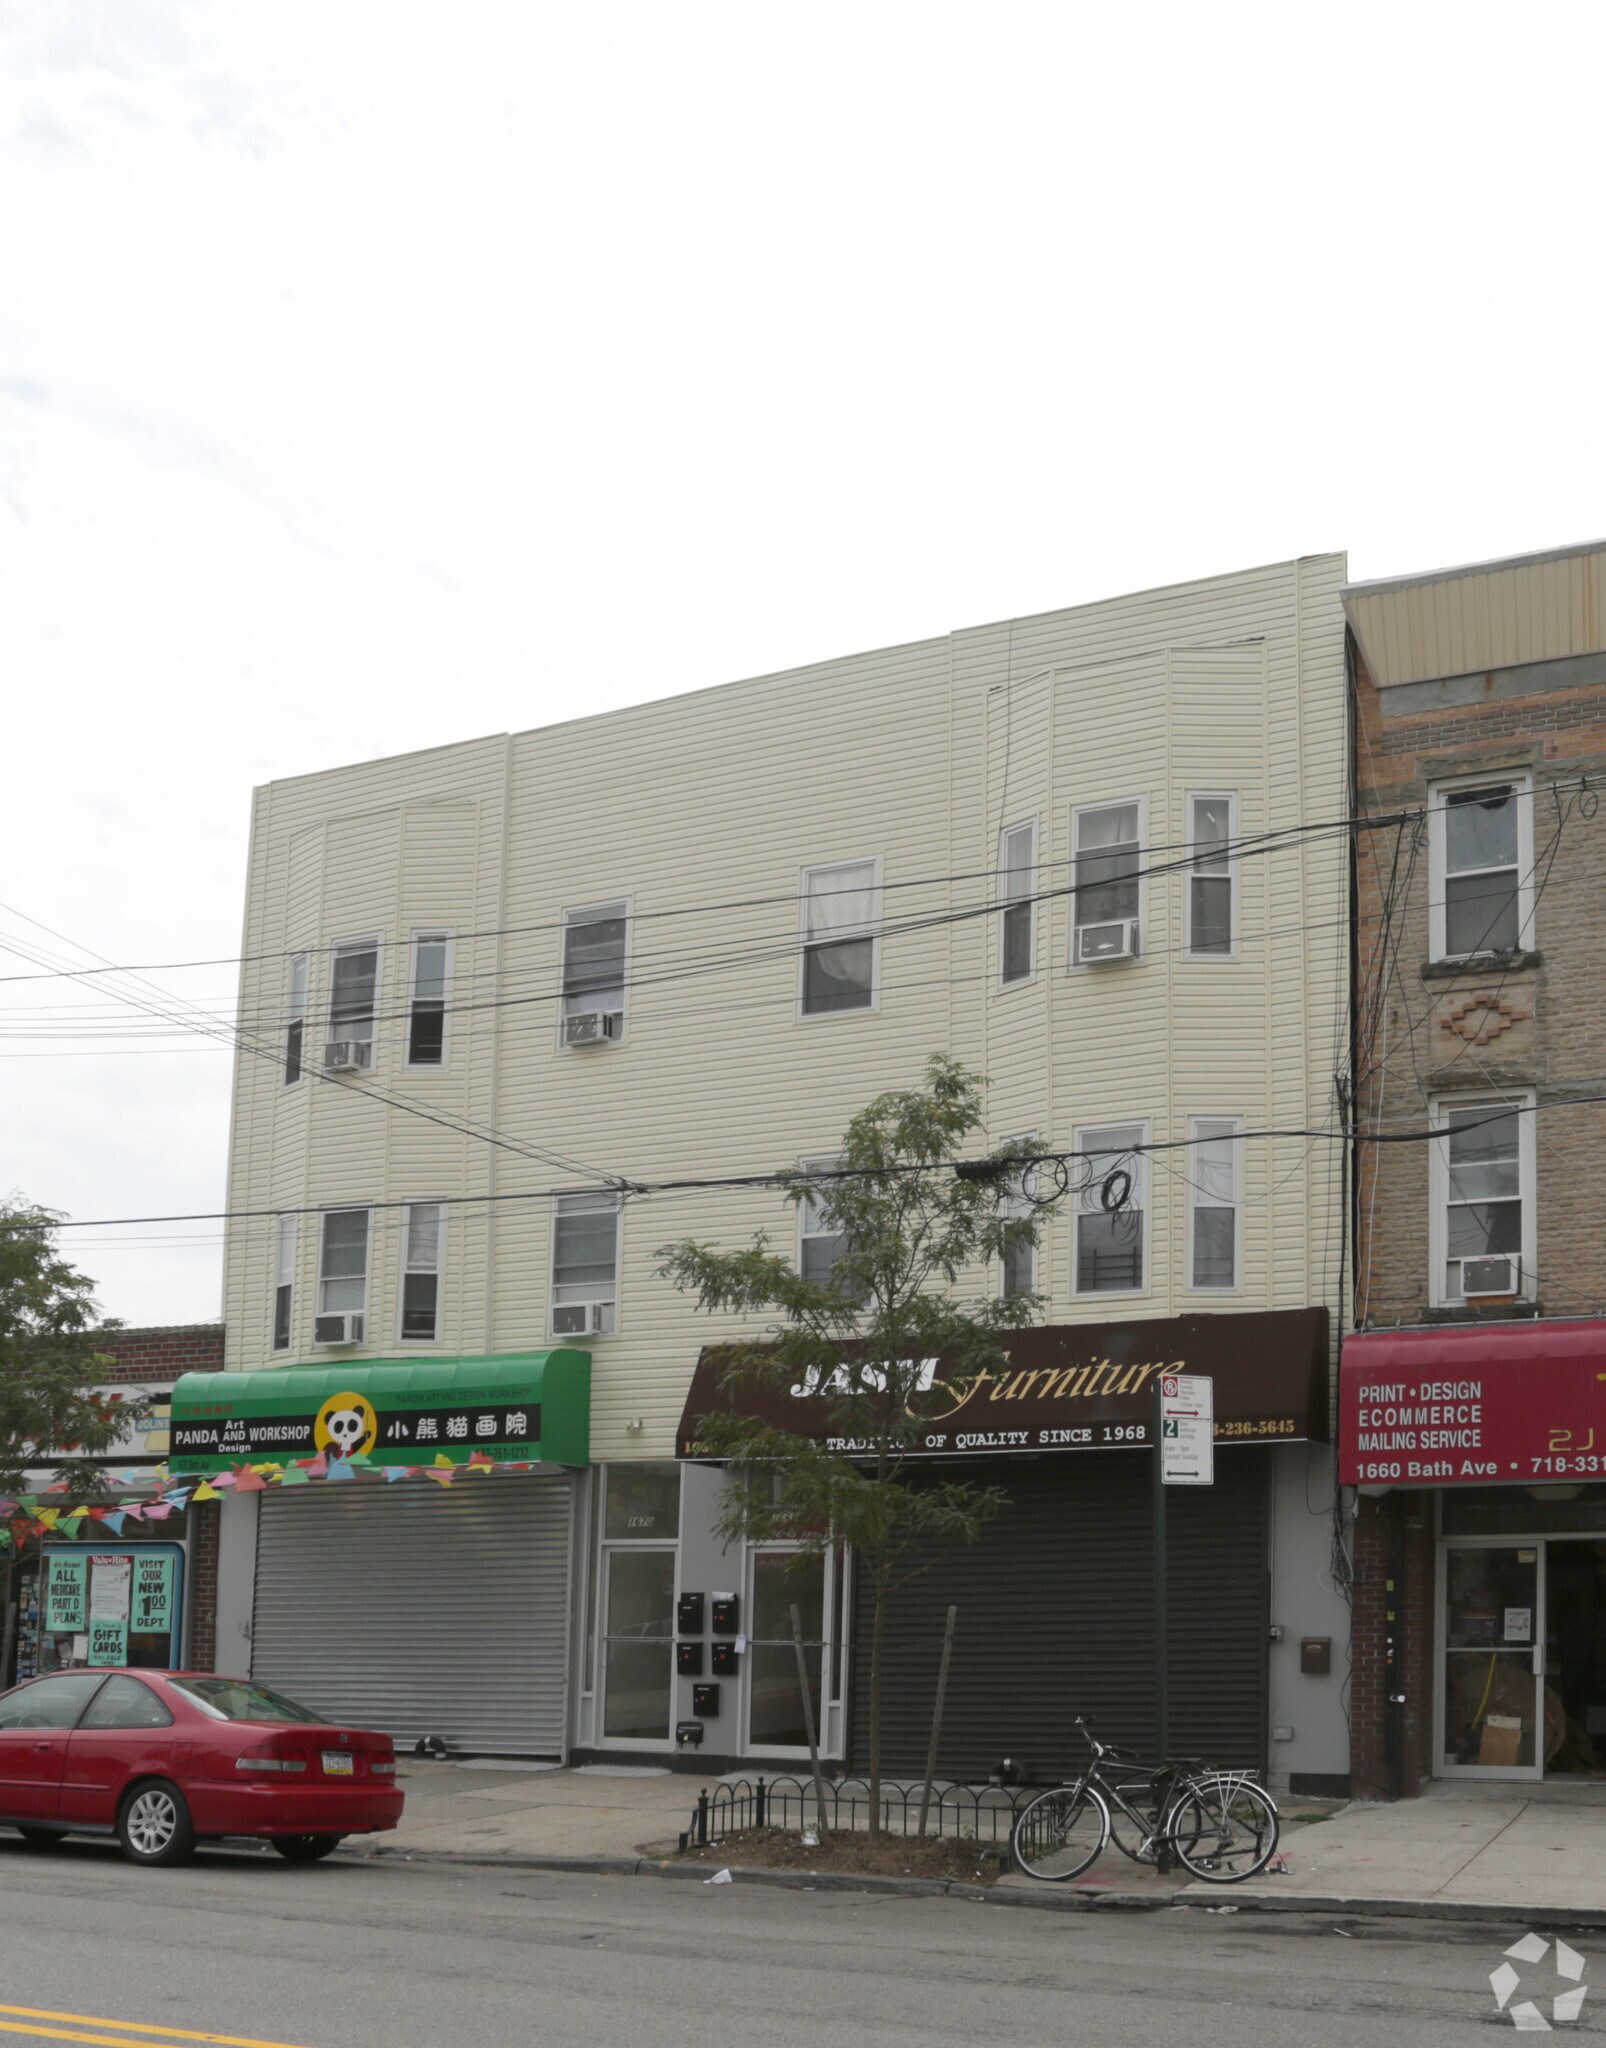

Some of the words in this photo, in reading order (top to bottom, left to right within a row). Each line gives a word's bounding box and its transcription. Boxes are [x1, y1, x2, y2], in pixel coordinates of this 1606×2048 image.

[1359, 1383, 1406, 1403] PRINT
[1420, 1381, 1482, 1401] DESIGN
[1358, 1405, 1482, 1427] ECOMMERCE
[225, 1420, 245, 1430] Art
[1166, 1420, 1175, 1437] 2
[175, 1429, 219, 1445] PANDA
[222, 1430, 246, 1442] AND
[249, 1425, 311, 1442] WORKSHOP
[925, 1433, 947, 1448] OF
[955, 1430, 1029, 1448] QUALITY
[1039, 1428, 1092, 1445] SINCE
[1102, 1425, 1146, 1442] 1968
[1358, 1431, 1417, 1451] MAILING
[1420, 1429, 1482, 1449] SERVICE
[218, 1443, 251, 1454] Design
[1356, 1463, 1401, 1479] 1660
[1408, 1460, 1453, 1477] Bath
[1460, 1460, 1498, 1476] Ave
[139, 1559, 166, 1569] VISIT
[55, 1570, 77, 1582] ALL
[141, 1569, 162, 1581] OUR
[50, 1584, 81, 1596] MEDICARE
[138, 1582, 165, 1594] NEW
[52, 1597, 71, 1610] PART
[73, 1598, 80, 1609] D
[53, 1611, 81, 1625] PLANS
[93, 1629, 122, 1641] GIFT
[92, 1641, 123, 1654] CARDS
